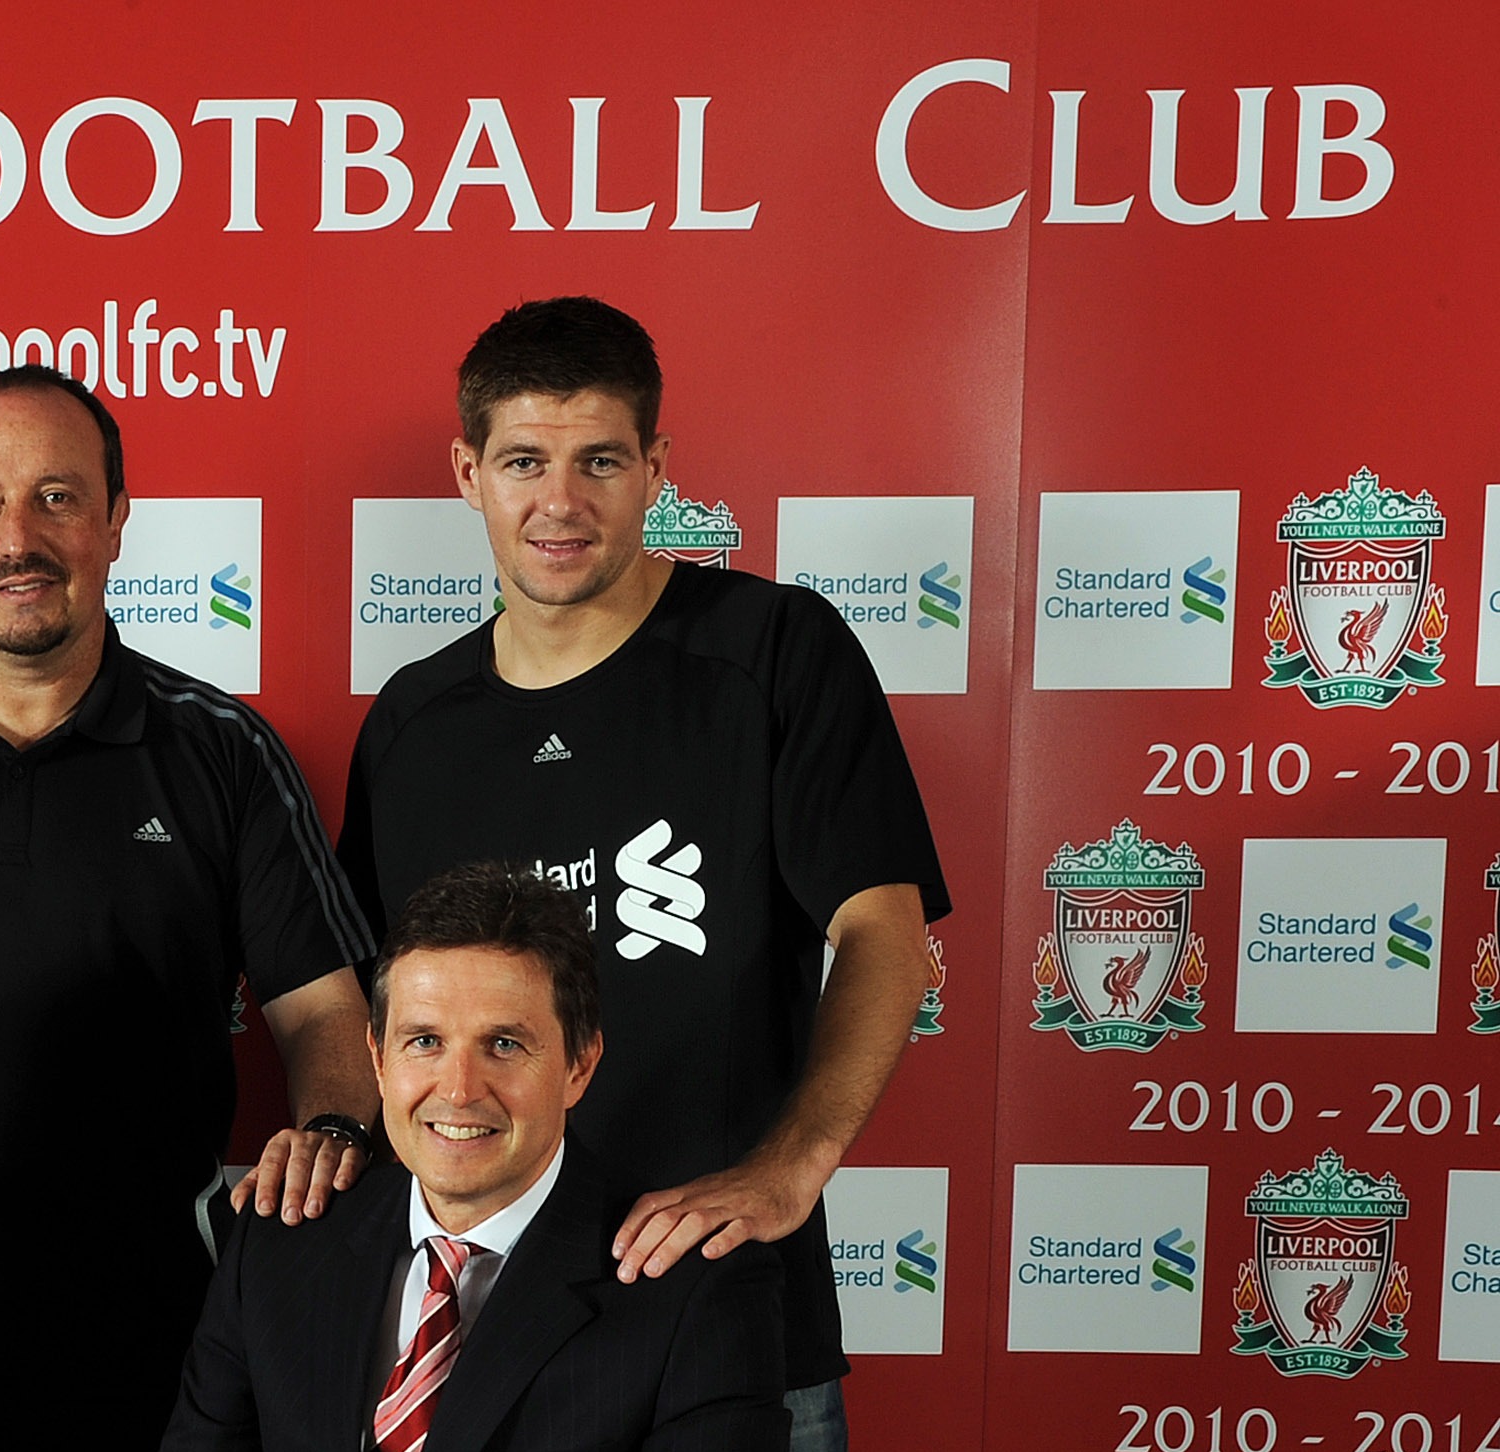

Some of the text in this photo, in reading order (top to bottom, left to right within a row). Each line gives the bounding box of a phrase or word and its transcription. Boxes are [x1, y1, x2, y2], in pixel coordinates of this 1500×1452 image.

[876, 59, 1394, 232] CLUB
[663, 534, 697, 544] WALK
[698, 534, 736, 545] ALONE
[1280, 524, 1441, 537] YOU'LL NEVER WALK ALONE
[1056, 568, 1170, 590] Standard
[1299, 560, 1419, 582] LIVERPOOL
[106, 574, 198, 595] tandard
[371, 574, 481, 595] Standard
[795, 573, 907, 594] Standard
[1303, 585, 1412, 598] FOOTBALL CLUB
[106, 602, 197, 623] artered
[360, 602, 481, 623] Chartered
[838, 601, 906, 622] tered
[1045, 596, 1169, 618] Chartered
[533, 750, 572, 763] adidas
[1143, 743, 1310, 795] 2010
[1384, 741, 1500, 795] 201
[133, 832, 172, 842] adidas
[1047, 874, 1200, 885] YOU'LL NEVER WALK ALONE
[1065, 909, 1180, 929] LIVERPOOL
[1259, 913, 1376, 934] Standard
[1069, 933, 1173, 944] FOOTBALL CLUB
[1247, 941, 1374, 962] Chartered
[1129, 1081, 1293, 1132] 2010
[1367, 1083, 1500, 1136] 201
[1248, 1201, 1404, 1215] YOU'LL NEVER WALK ALONE
[831, 1239, 884, 1260] dard
[1030, 1236, 1141, 1258] Standard
[1266, 1236, 1384, 1258] LIVERPOOL
[1019, 1263, 1140, 1285] Chartered
[1271, 1260, 1376, 1272] FOOTBALL CLUB
